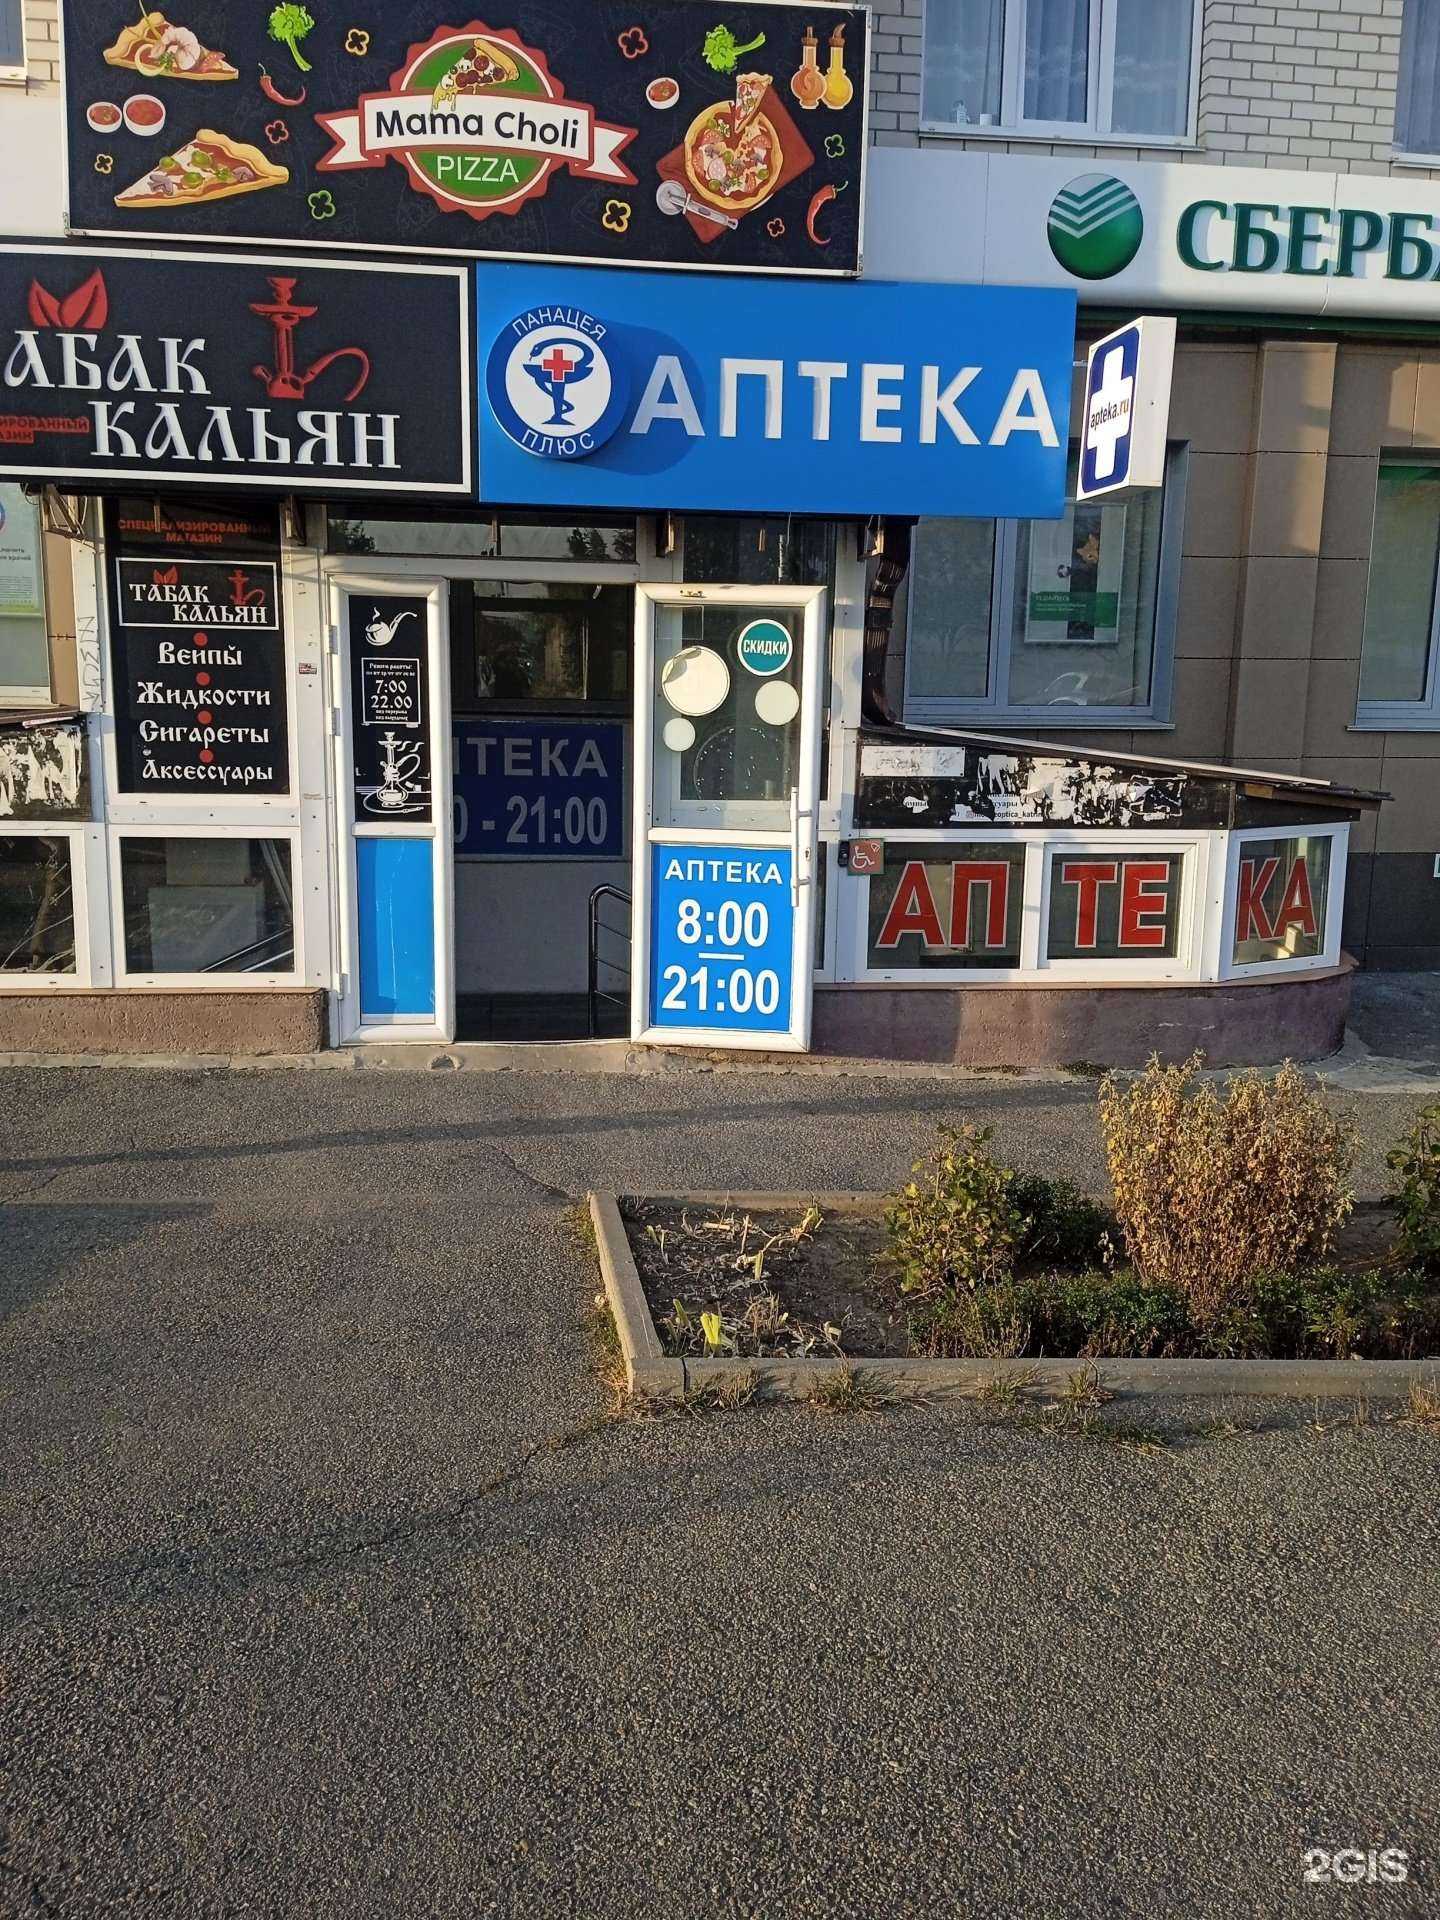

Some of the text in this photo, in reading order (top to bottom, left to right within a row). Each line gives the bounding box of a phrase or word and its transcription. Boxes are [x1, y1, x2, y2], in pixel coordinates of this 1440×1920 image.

[376, 109, 579, 148] Mama Choli
[437, 155, 519, 183] PIZZA
[1176, 199, 1440, 282] СБЕРБ
[512, 307, 607, 341] ПАНАЦЕЯ
[629, 355, 1059, 448] АПТЕКА
[1090, 398, 1129, 431] apteka.ru
[88, 401, 400, 469] КАЛЬЯН
[521, 429, 594, 455] ПЛЮС
[166, 532, 223, 543] МАГАЗИН
[129, 583, 210, 603] ТАБАК
[173, 603, 268, 624] КАЛЬЯН
[743, 639, 787, 656] СКИДКИ
[136, 681, 271, 710] Жидкости
[376, 679, 407, 694] 7:00
[371, 695, 412, 709] 22.00
[139, 719, 269, 749] Сигареты
[452, 737, 608, 777] ТЕКА
[142, 759, 272, 786] Аксессуары
[506, 795, 608, 845] 21:00
[664, 859, 783, 885] АПТЕКА
[676, 898, 769, 947] 8:00
[662, 965, 780, 1014] 21:00
